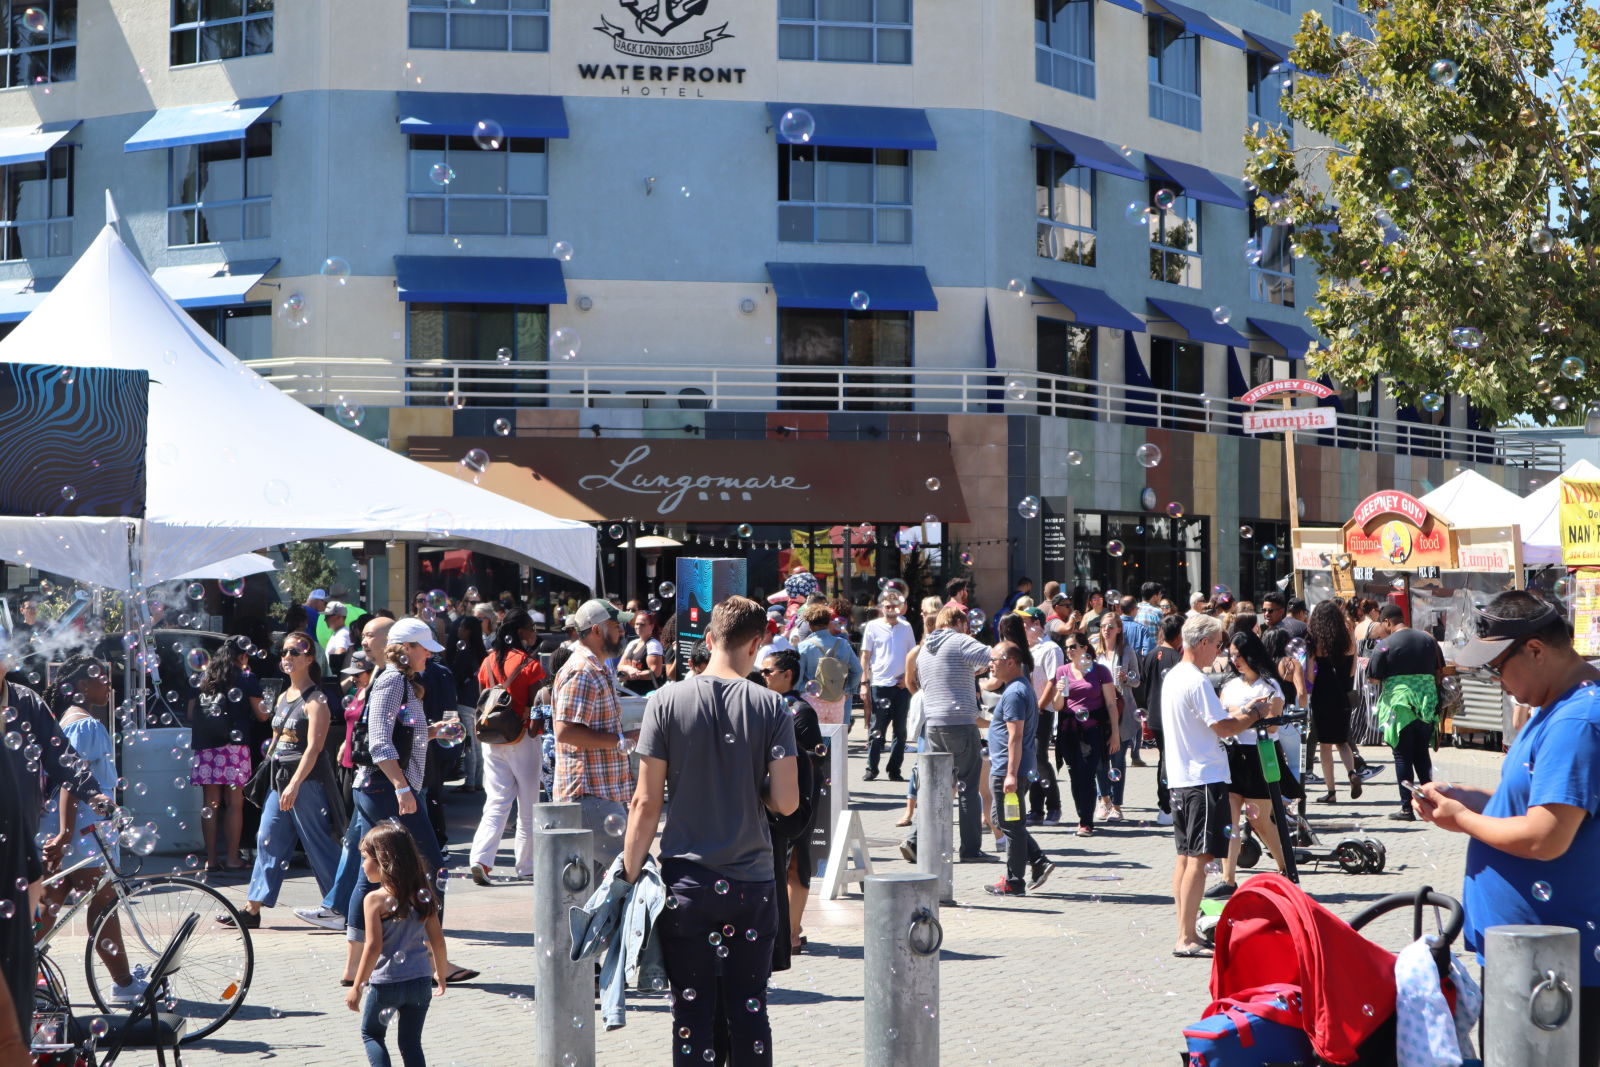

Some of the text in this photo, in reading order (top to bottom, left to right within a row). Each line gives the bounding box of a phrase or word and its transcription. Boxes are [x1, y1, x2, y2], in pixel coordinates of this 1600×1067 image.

[616, 42, 711, 57] JACK LONDON SQUARE
[578, 64, 747, 83] WATERFRONT
[621, 86, 704, 98] HOTEL
[1250, 381, 1324, 400] JEEPNEY GUY
[1248, 412, 1325, 430] Lumpia
[578, 445, 811, 515] Lungomare
[1361, 495, 1421, 521] JEEPNEY GUY
[1350, 534, 1440, 553] filipino food
[1568, 525, 1591, 543] NAN
[1297, 552, 1322, 567] Lecho
[1461, 552, 1503, 571] Lumpia
